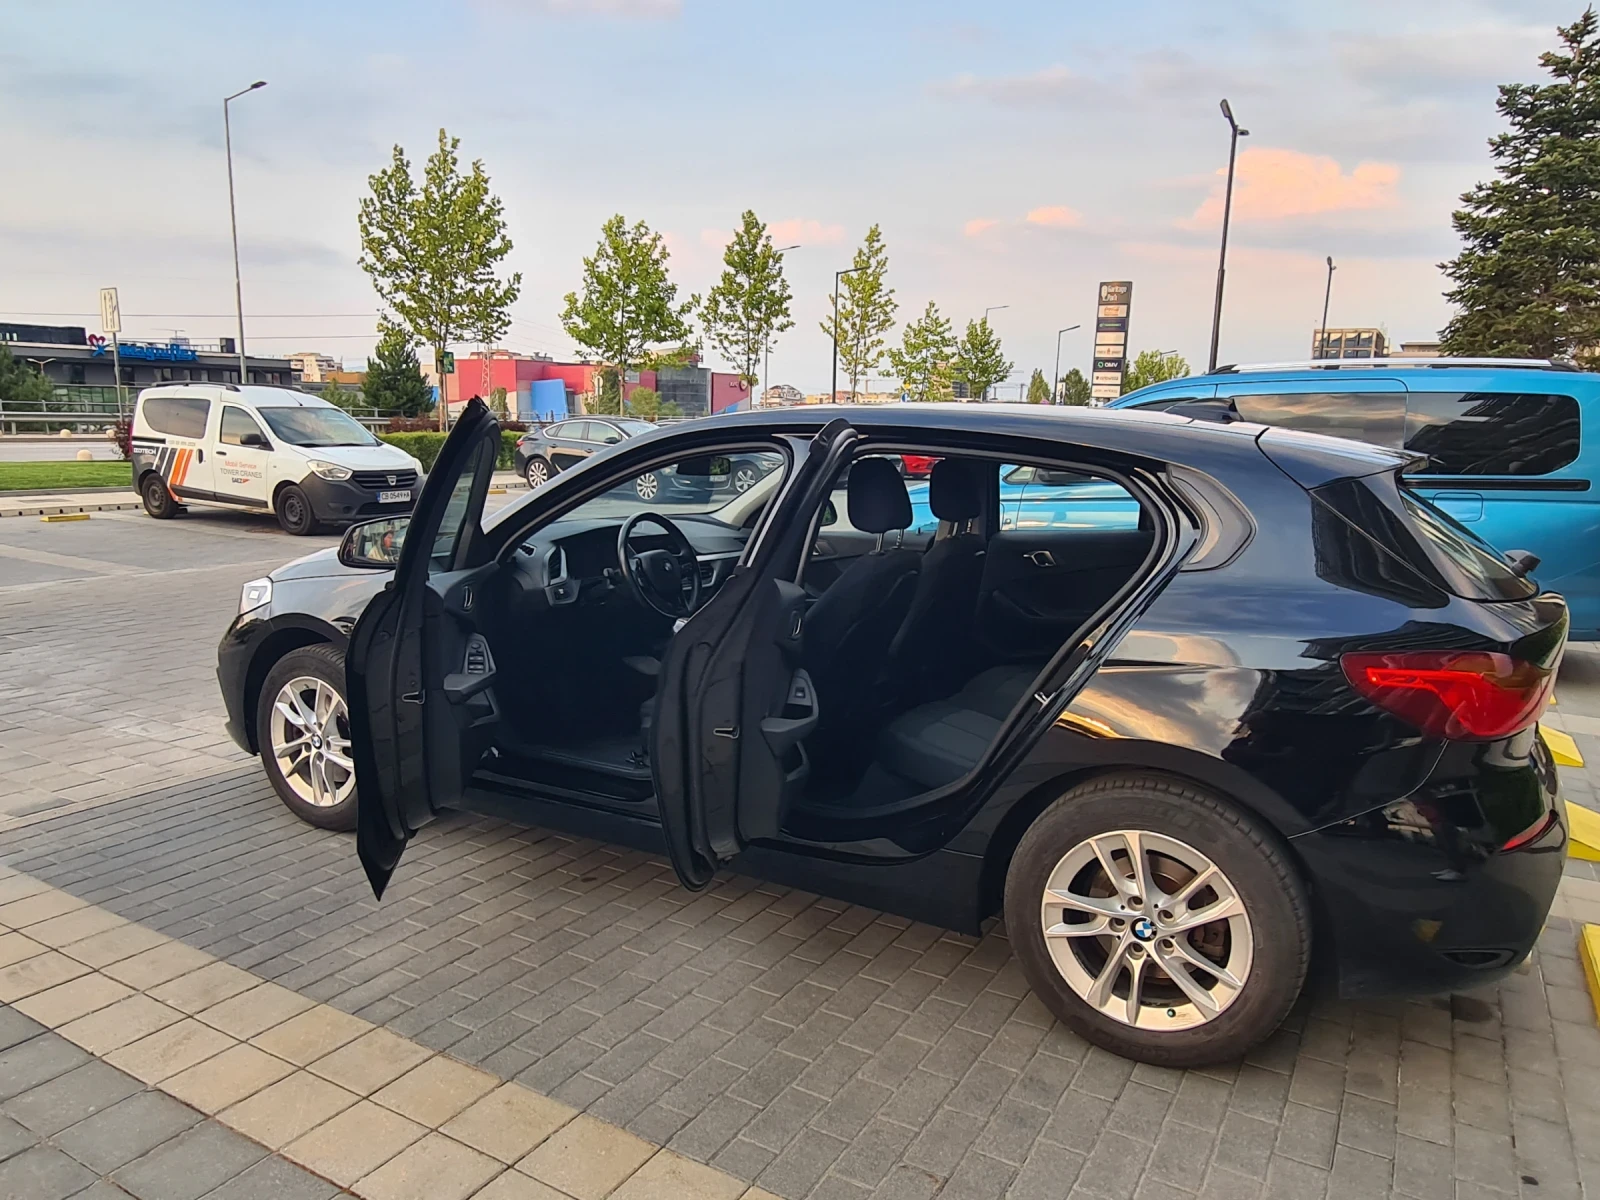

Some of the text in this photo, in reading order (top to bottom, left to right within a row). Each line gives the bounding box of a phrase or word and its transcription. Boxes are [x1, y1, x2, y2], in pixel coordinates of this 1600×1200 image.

[238, 461, 257, 469] Service
[220, 468, 263, 479] TOWER CRANES
